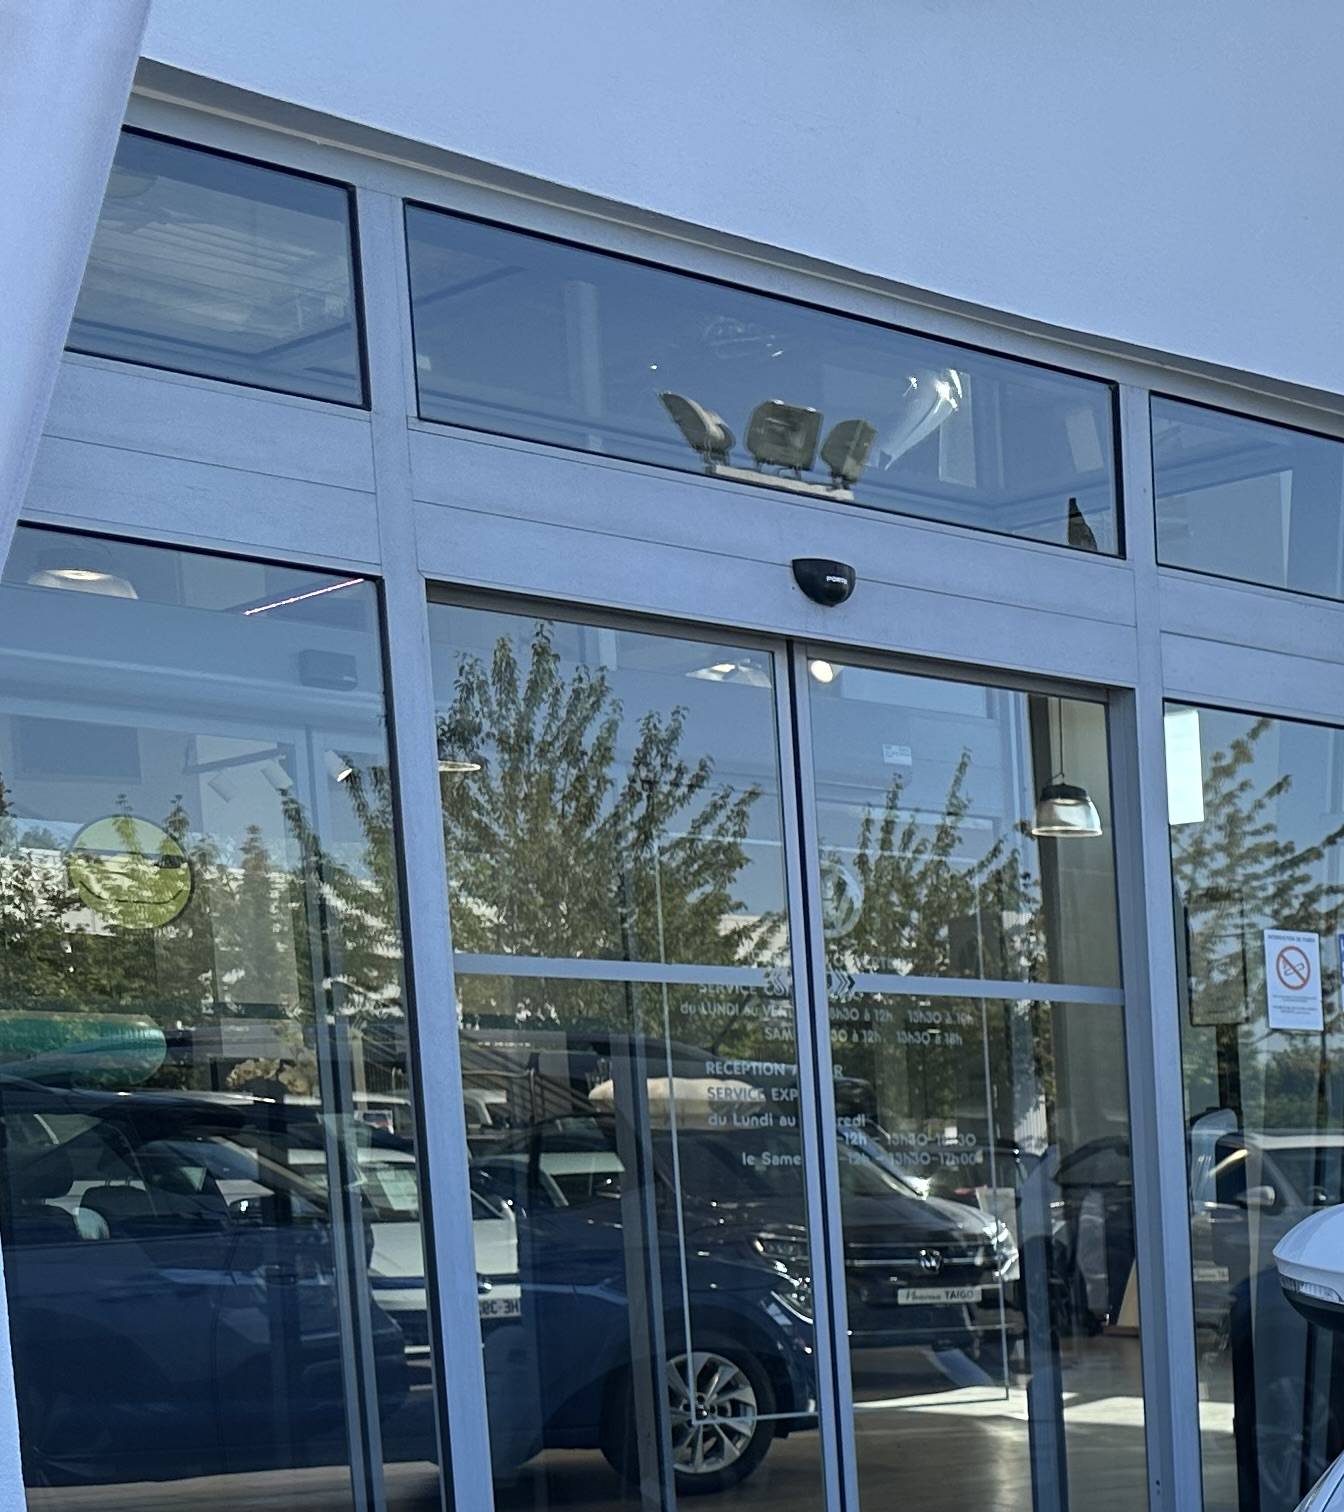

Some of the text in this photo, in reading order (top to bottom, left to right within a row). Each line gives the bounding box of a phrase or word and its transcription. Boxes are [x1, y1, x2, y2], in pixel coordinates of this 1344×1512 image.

[701, 1002, 739, 1016] LUNDI
[907, 1010, 942, 1024] 13h30
[705, 1060, 785, 1077] RECEPTION
[707, 1086, 766, 1101] SERVICE
[708, 1114, 727, 1126] du
[733, 1112, 773, 1127] Lundi
[779, 1117, 796, 1127] au
[742, 1150, 755, 1166] le
[944, 1289, 974, 1300] TAIGO
